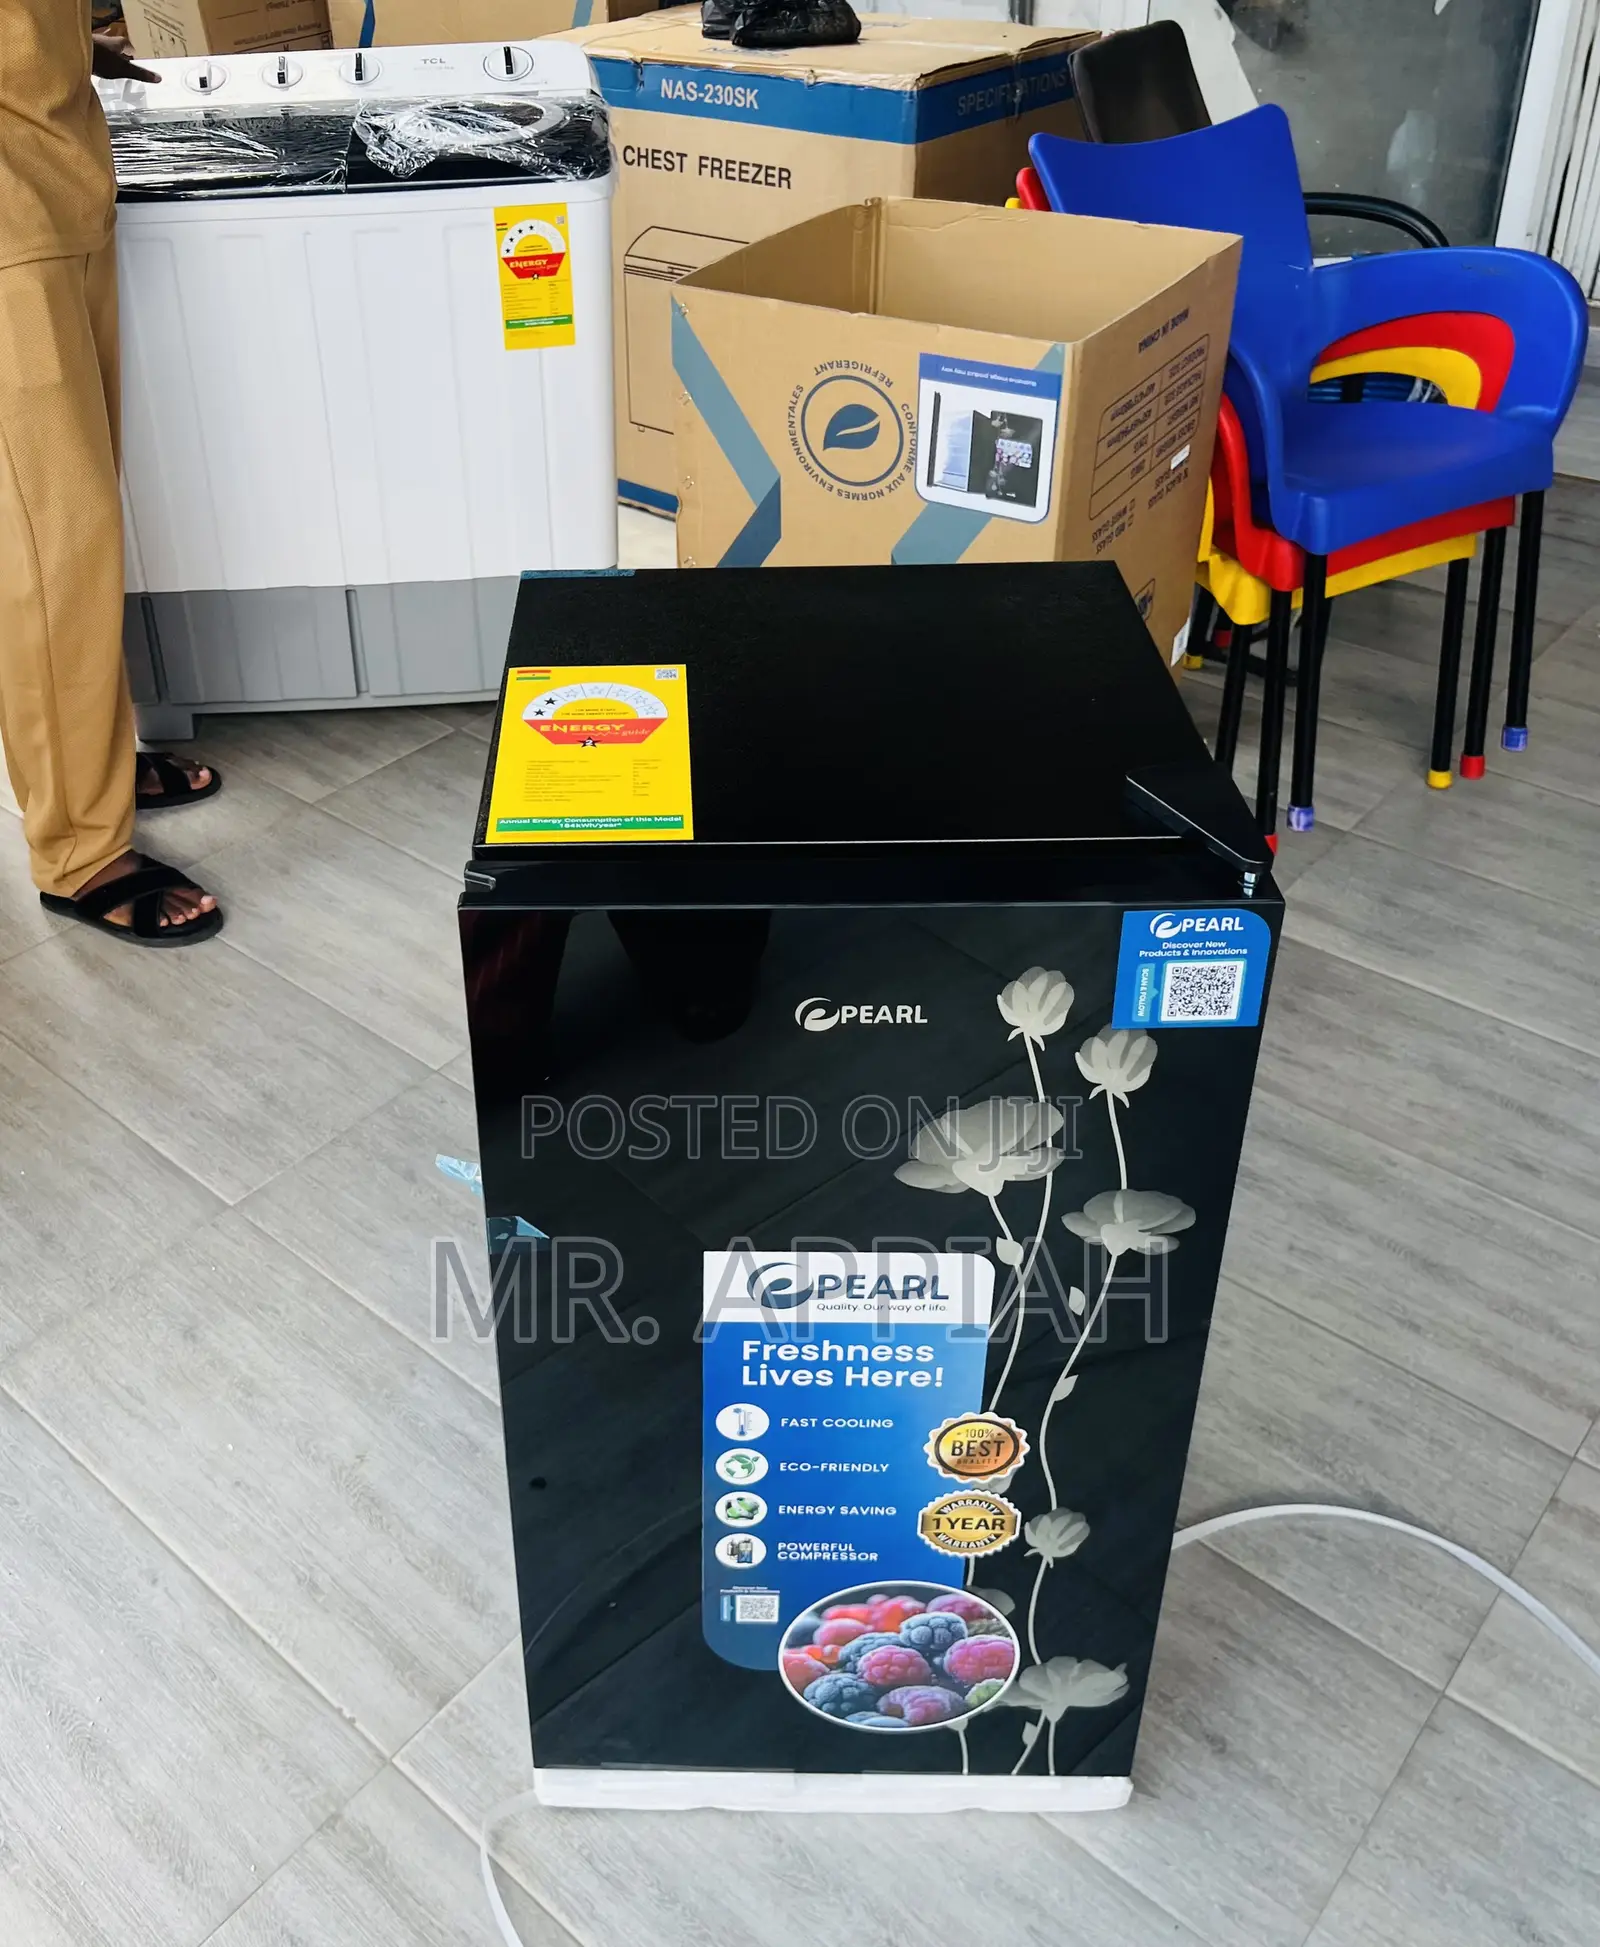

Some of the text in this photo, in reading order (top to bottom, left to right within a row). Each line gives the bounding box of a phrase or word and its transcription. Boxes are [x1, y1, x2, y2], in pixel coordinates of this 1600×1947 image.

[421, 57, 446, 65] TCL
[660, 78, 760, 110] NAS-230SK
[622, 145, 792, 190] CHEST FREEZER
[509, 259, 548, 269] ENERGY
[788, 384, 917, 501] CONFORME AUX NORMES ENVIRONMENTALES
[540, 723, 625, 733] ENERGY
[532, 817, 562, 825] Energy
[564, 816, 624, 824] Consumption
[1181, 917, 1244, 932] PEARL
[1162, 940, 1227, 949] Discover New
[1139, 949, 1181, 957] Products
[1191, 947, 1248, 956] Innovations
[1141, 968, 1149, 986] SCAN
[1138, 991, 1147, 1017] FOLLOW
[841, 1005, 928, 1025] PEARL
[817, 1274, 949, 1300] PEARL
[816, 1303, 948, 1312] Quality. Our way of life.
[742, 1340, 934, 1362] Freshness
[742, 1364, 944, 1387] Lives Here!
[780, 1418, 894, 1428] FAST COOLING
[965, 1428, 994, 1438] 100%
[951, 1440, 1005, 1457] BEST
[779, 1462, 889, 1473] ECO-FRIENDLY
[778, 1505, 897, 1516] ENERGY SAVING
[940, 1499, 1000, 1514] WARRANTY
[932, 1517, 1006, 1530] 1 YEAR
[777, 1541, 855, 1551] POWERFUL
[938, 1533, 996, 1548] WARRANTY
[777, 1551, 878, 1561] COMPRESSOR
